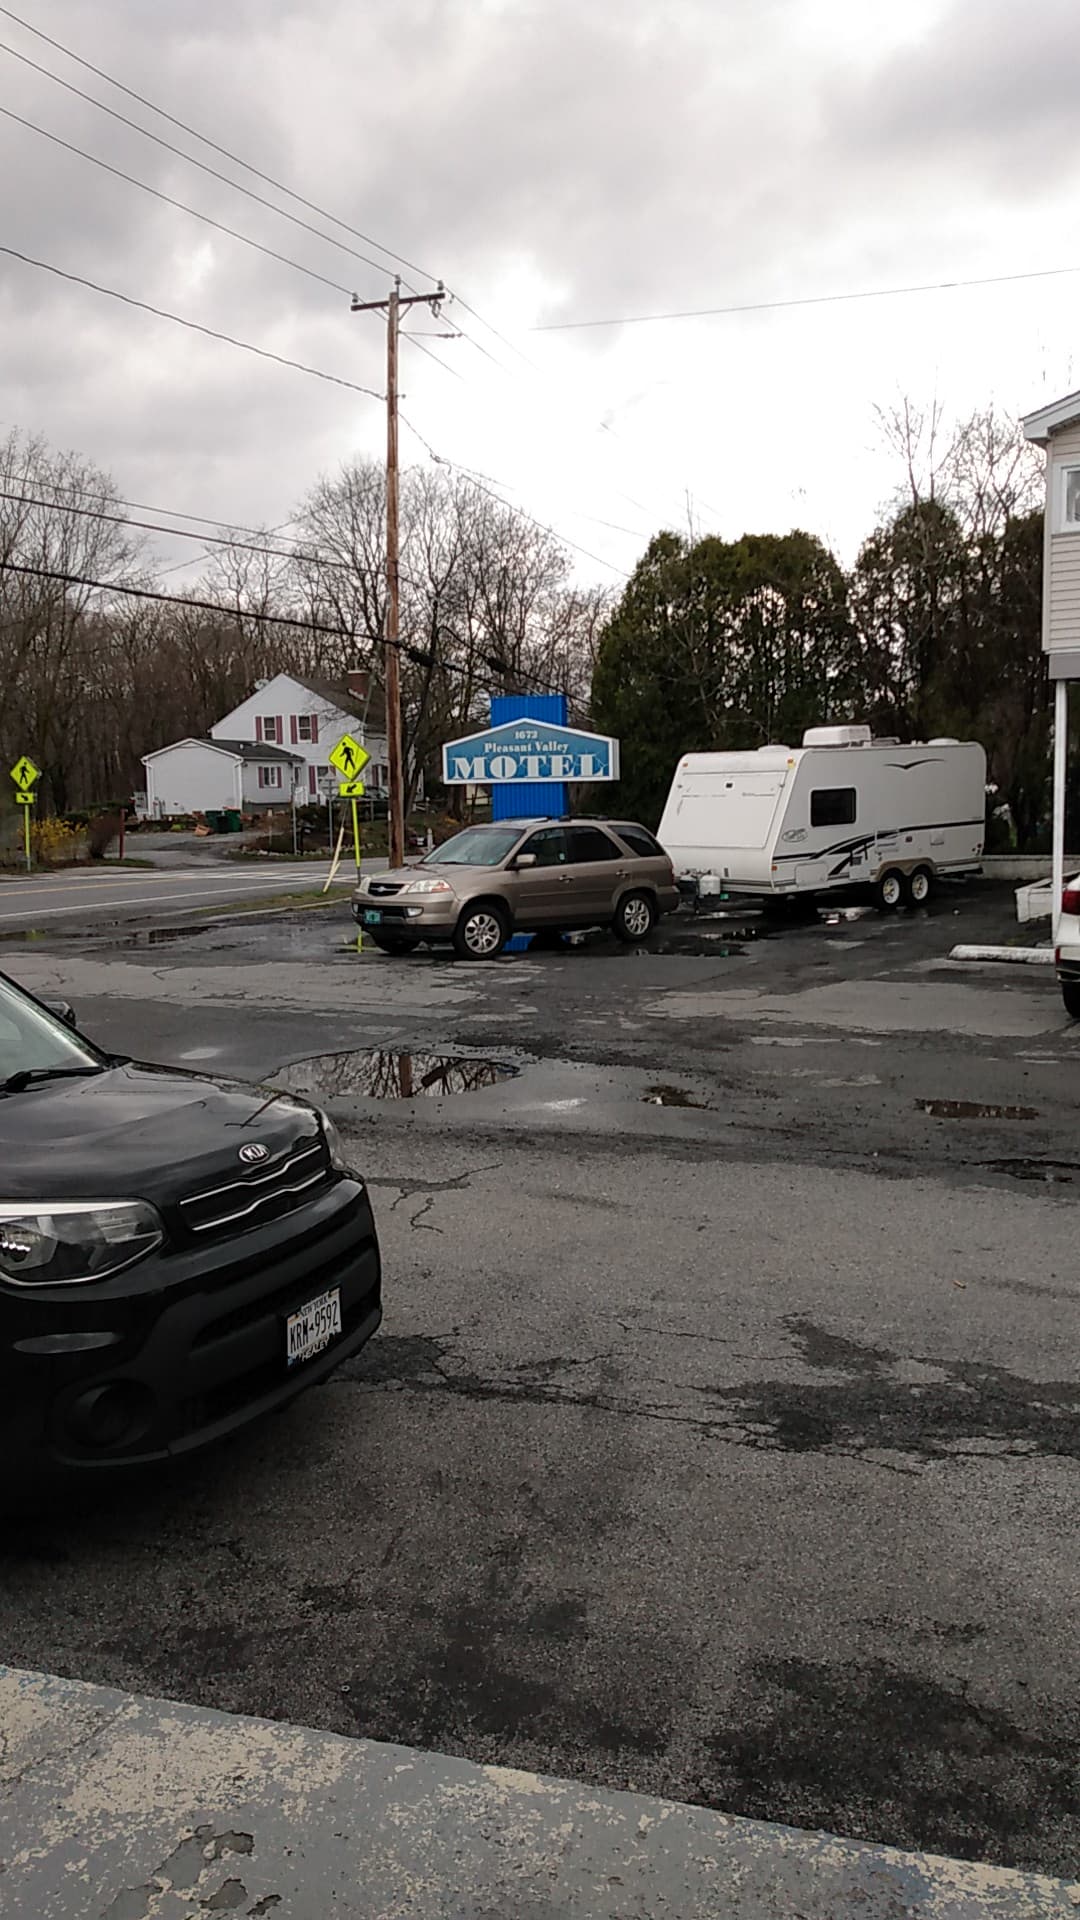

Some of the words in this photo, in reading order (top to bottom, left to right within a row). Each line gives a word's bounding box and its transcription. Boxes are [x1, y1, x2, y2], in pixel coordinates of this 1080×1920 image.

[484, 741, 532, 753] Pleasant
[536, 741, 569, 754] Valley
[452, 754, 604, 780] MOTEL
